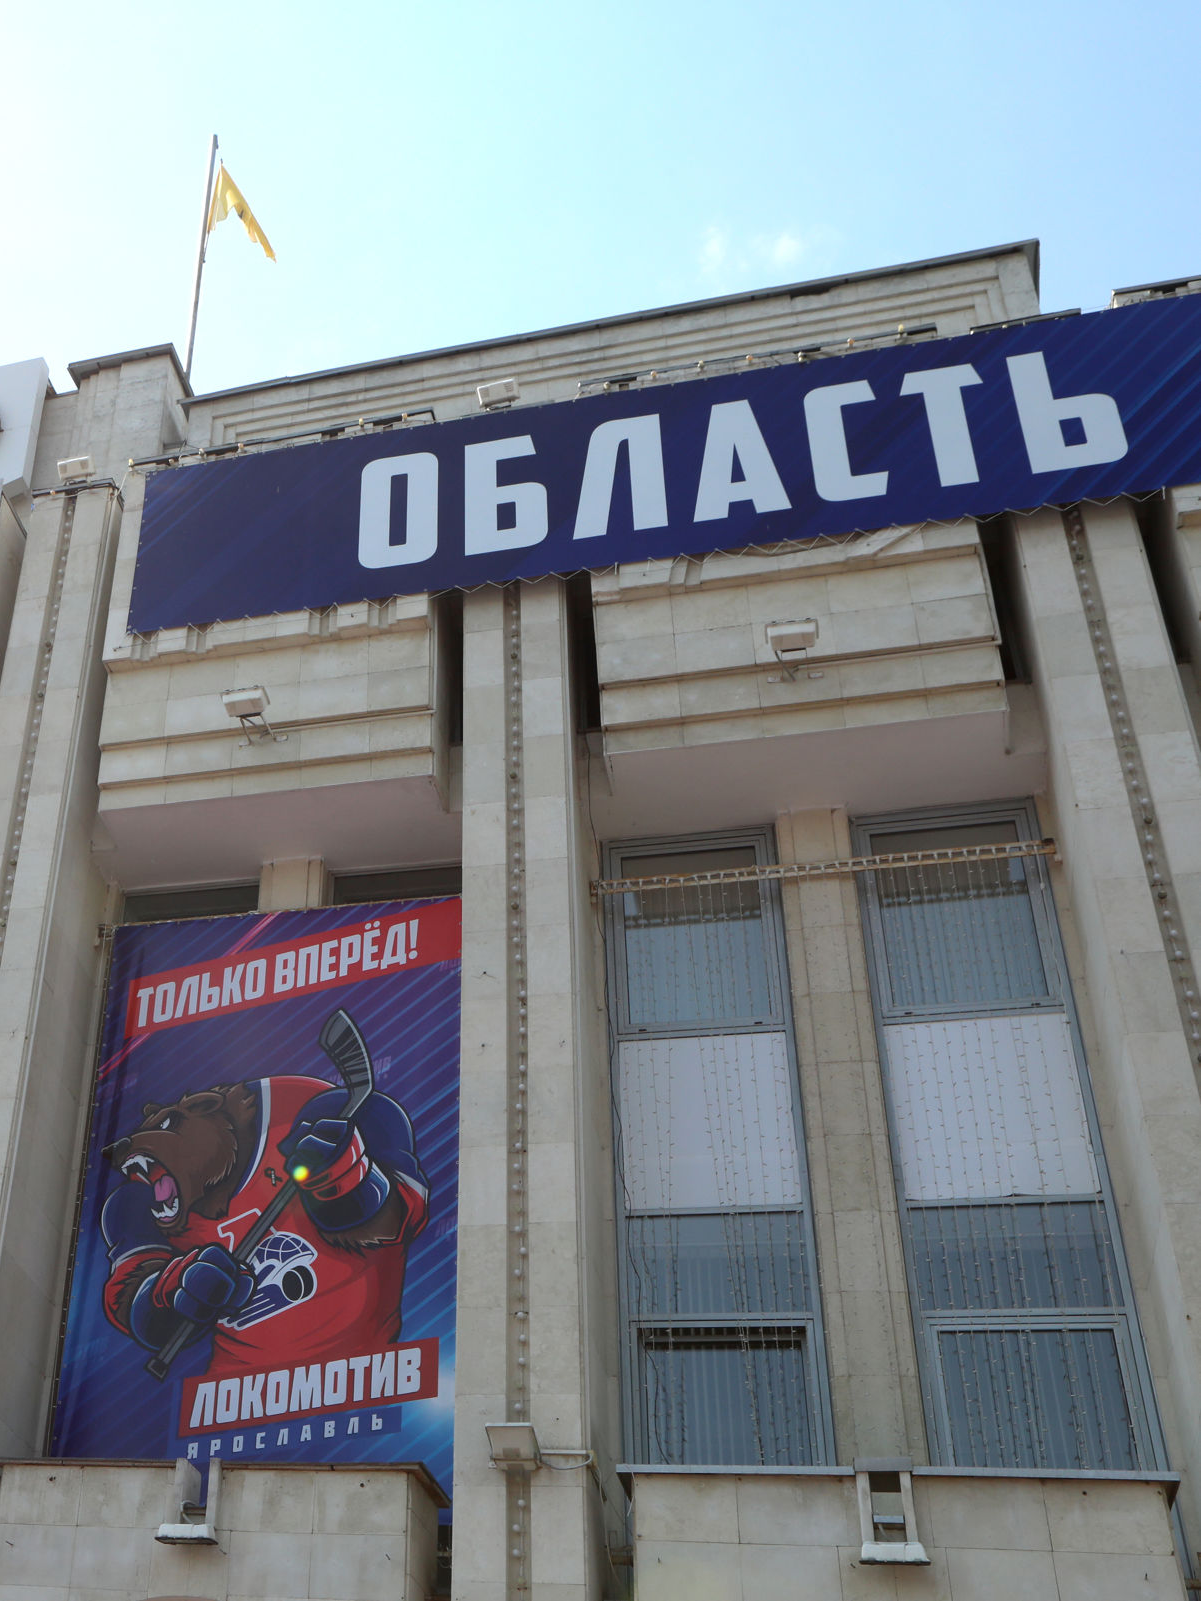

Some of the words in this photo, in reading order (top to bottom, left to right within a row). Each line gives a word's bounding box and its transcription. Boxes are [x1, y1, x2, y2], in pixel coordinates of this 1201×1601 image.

[359, 352, 1127, 568] ОБЛАСТЬ
[137, 957, 266, 1028] ТОЛЬКО
[273, 919, 419, 993] ВПЕРЁД!
[190, 1346, 422, 1428] ЛОКОМОТИВ
[187, 1413, 383, 1459] ЯРОСЛАВЛЬ
